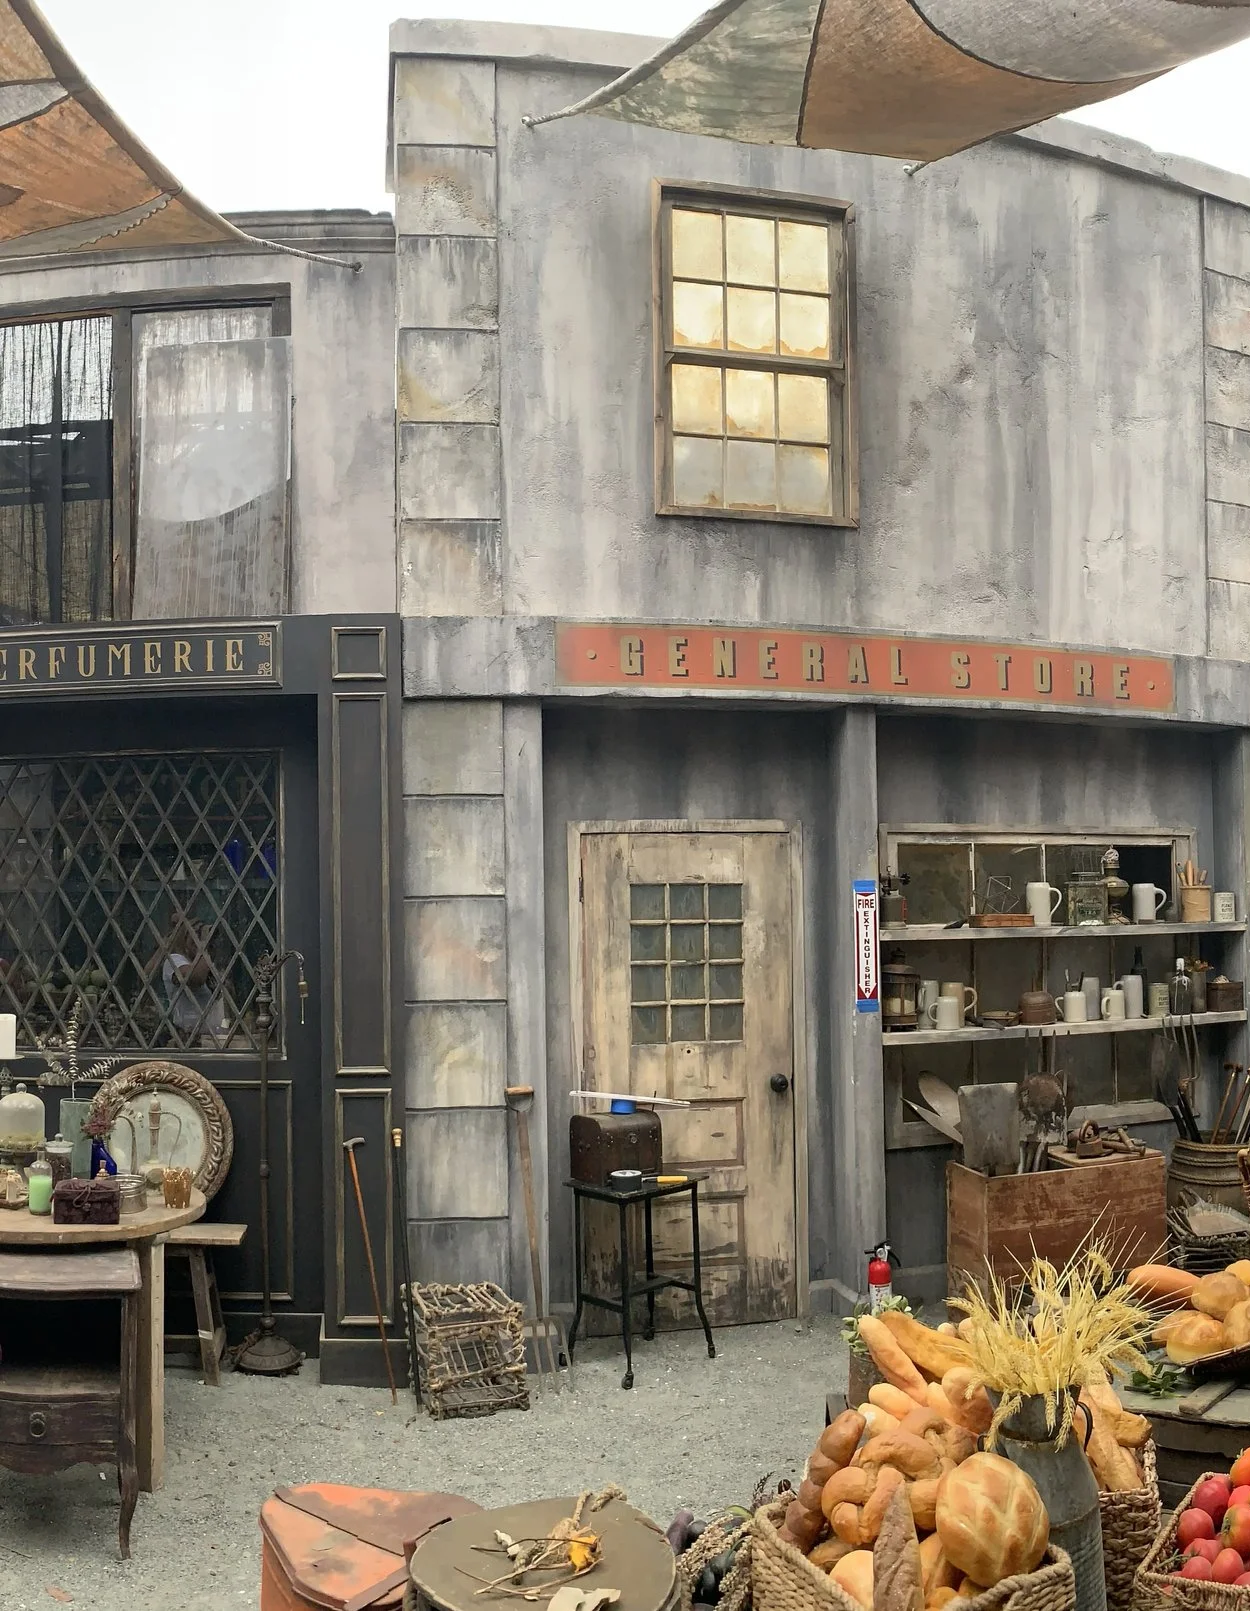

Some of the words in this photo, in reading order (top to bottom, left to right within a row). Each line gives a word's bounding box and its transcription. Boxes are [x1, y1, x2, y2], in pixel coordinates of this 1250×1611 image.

[620, 634, 908, 685] GENERAL
[950, 651, 1131, 700] STORE
[857, 898, 875, 909] FIRE
[863, 910, 871, 994] EXTINGUISHER
